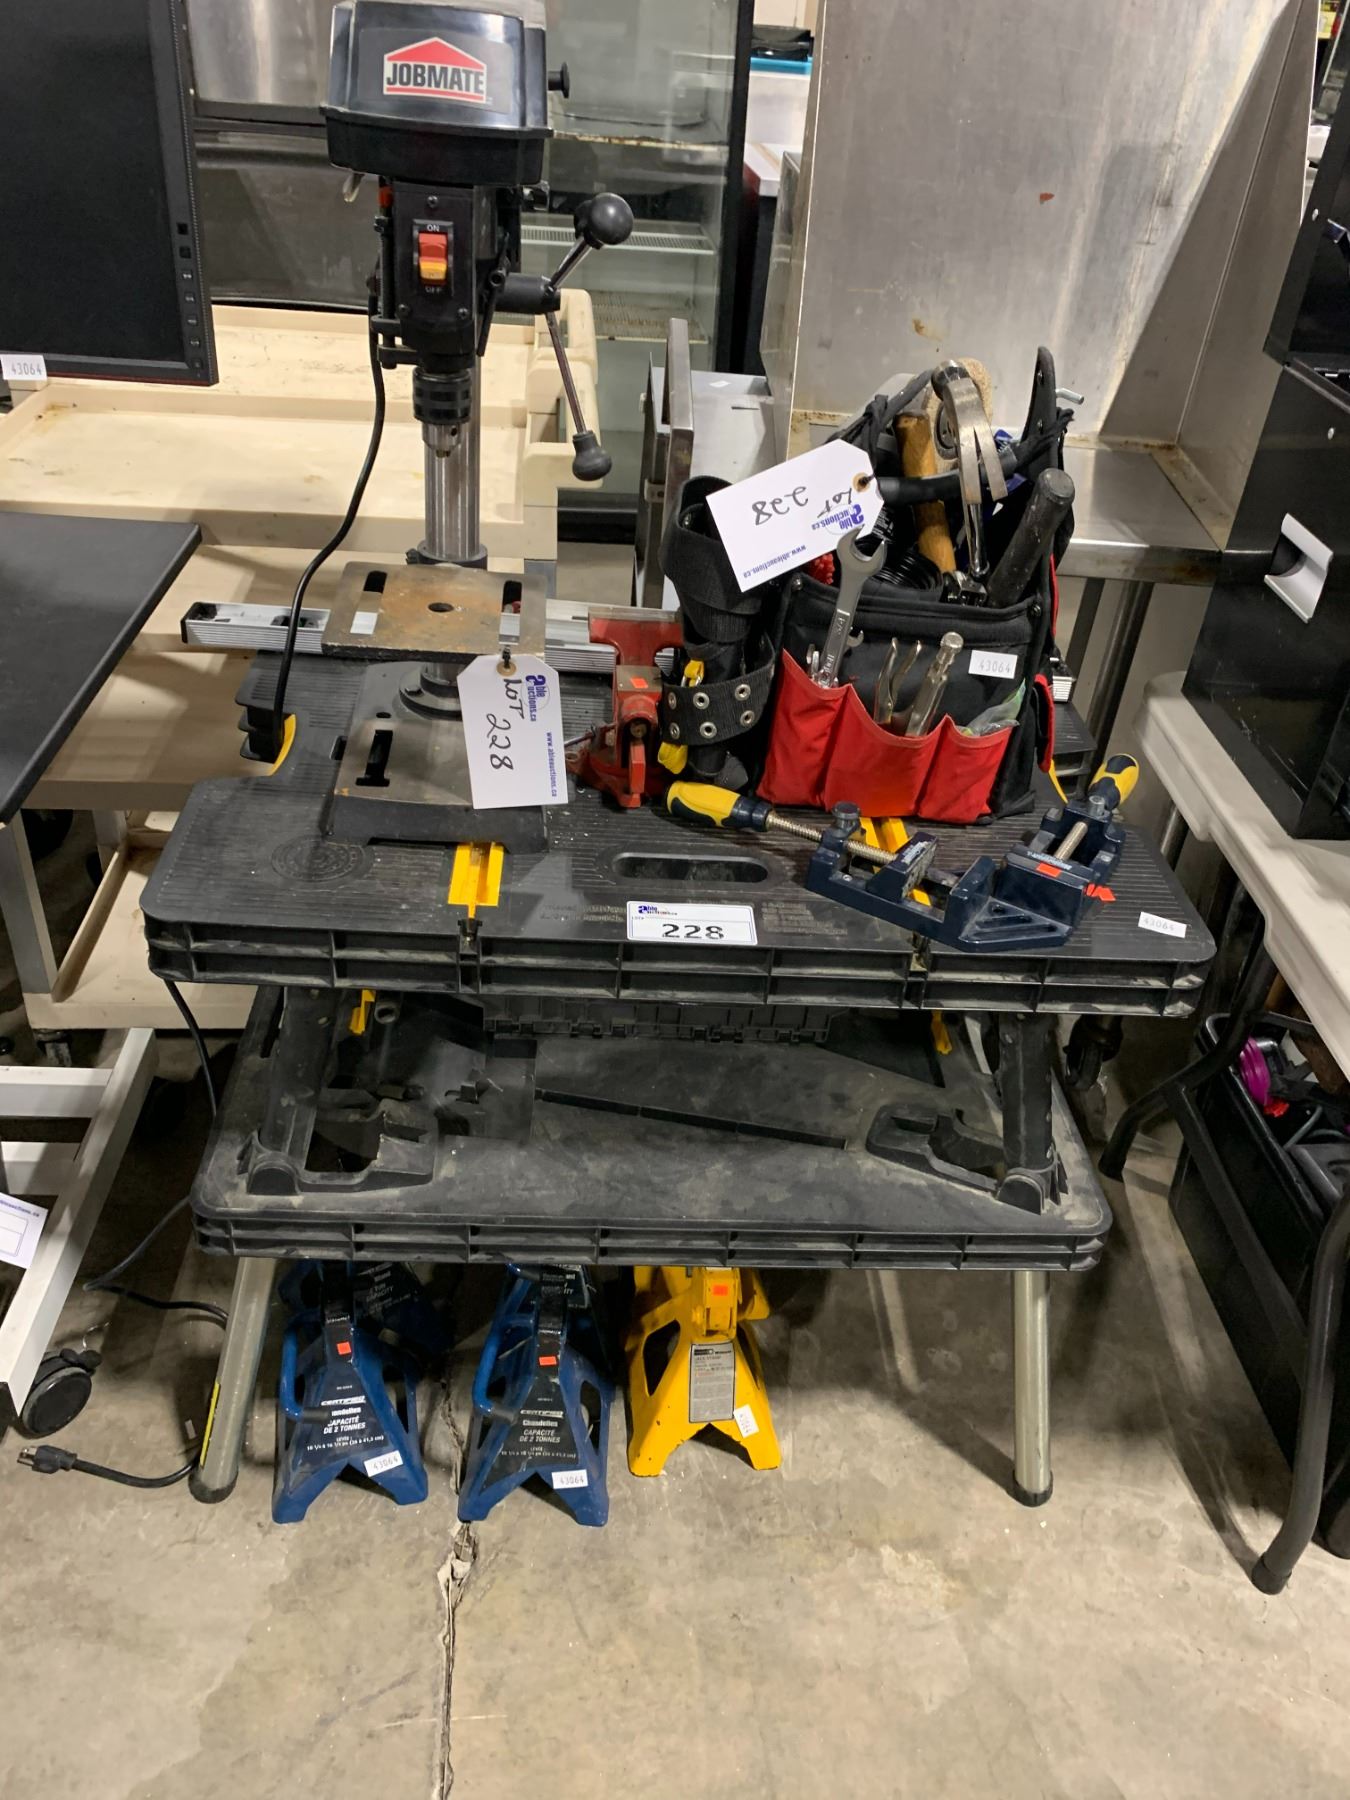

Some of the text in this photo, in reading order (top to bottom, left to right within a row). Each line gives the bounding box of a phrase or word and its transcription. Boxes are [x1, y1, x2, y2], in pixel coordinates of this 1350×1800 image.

[386, 62, 484, 94] JOBMATE
[426, 224, 440, 232] ON
[11, 362, 42, 375] 43064
[751, 485, 809, 526] 228
[979, 660, 1010, 673] 43064
[486, 713, 514, 770] 228
[662, 923, 725, 940] 228
[340, 1422, 366, 1432] TONNES
[373, 1456, 399, 1471] 43064
[560, 1477, 585, 1486] 43064
